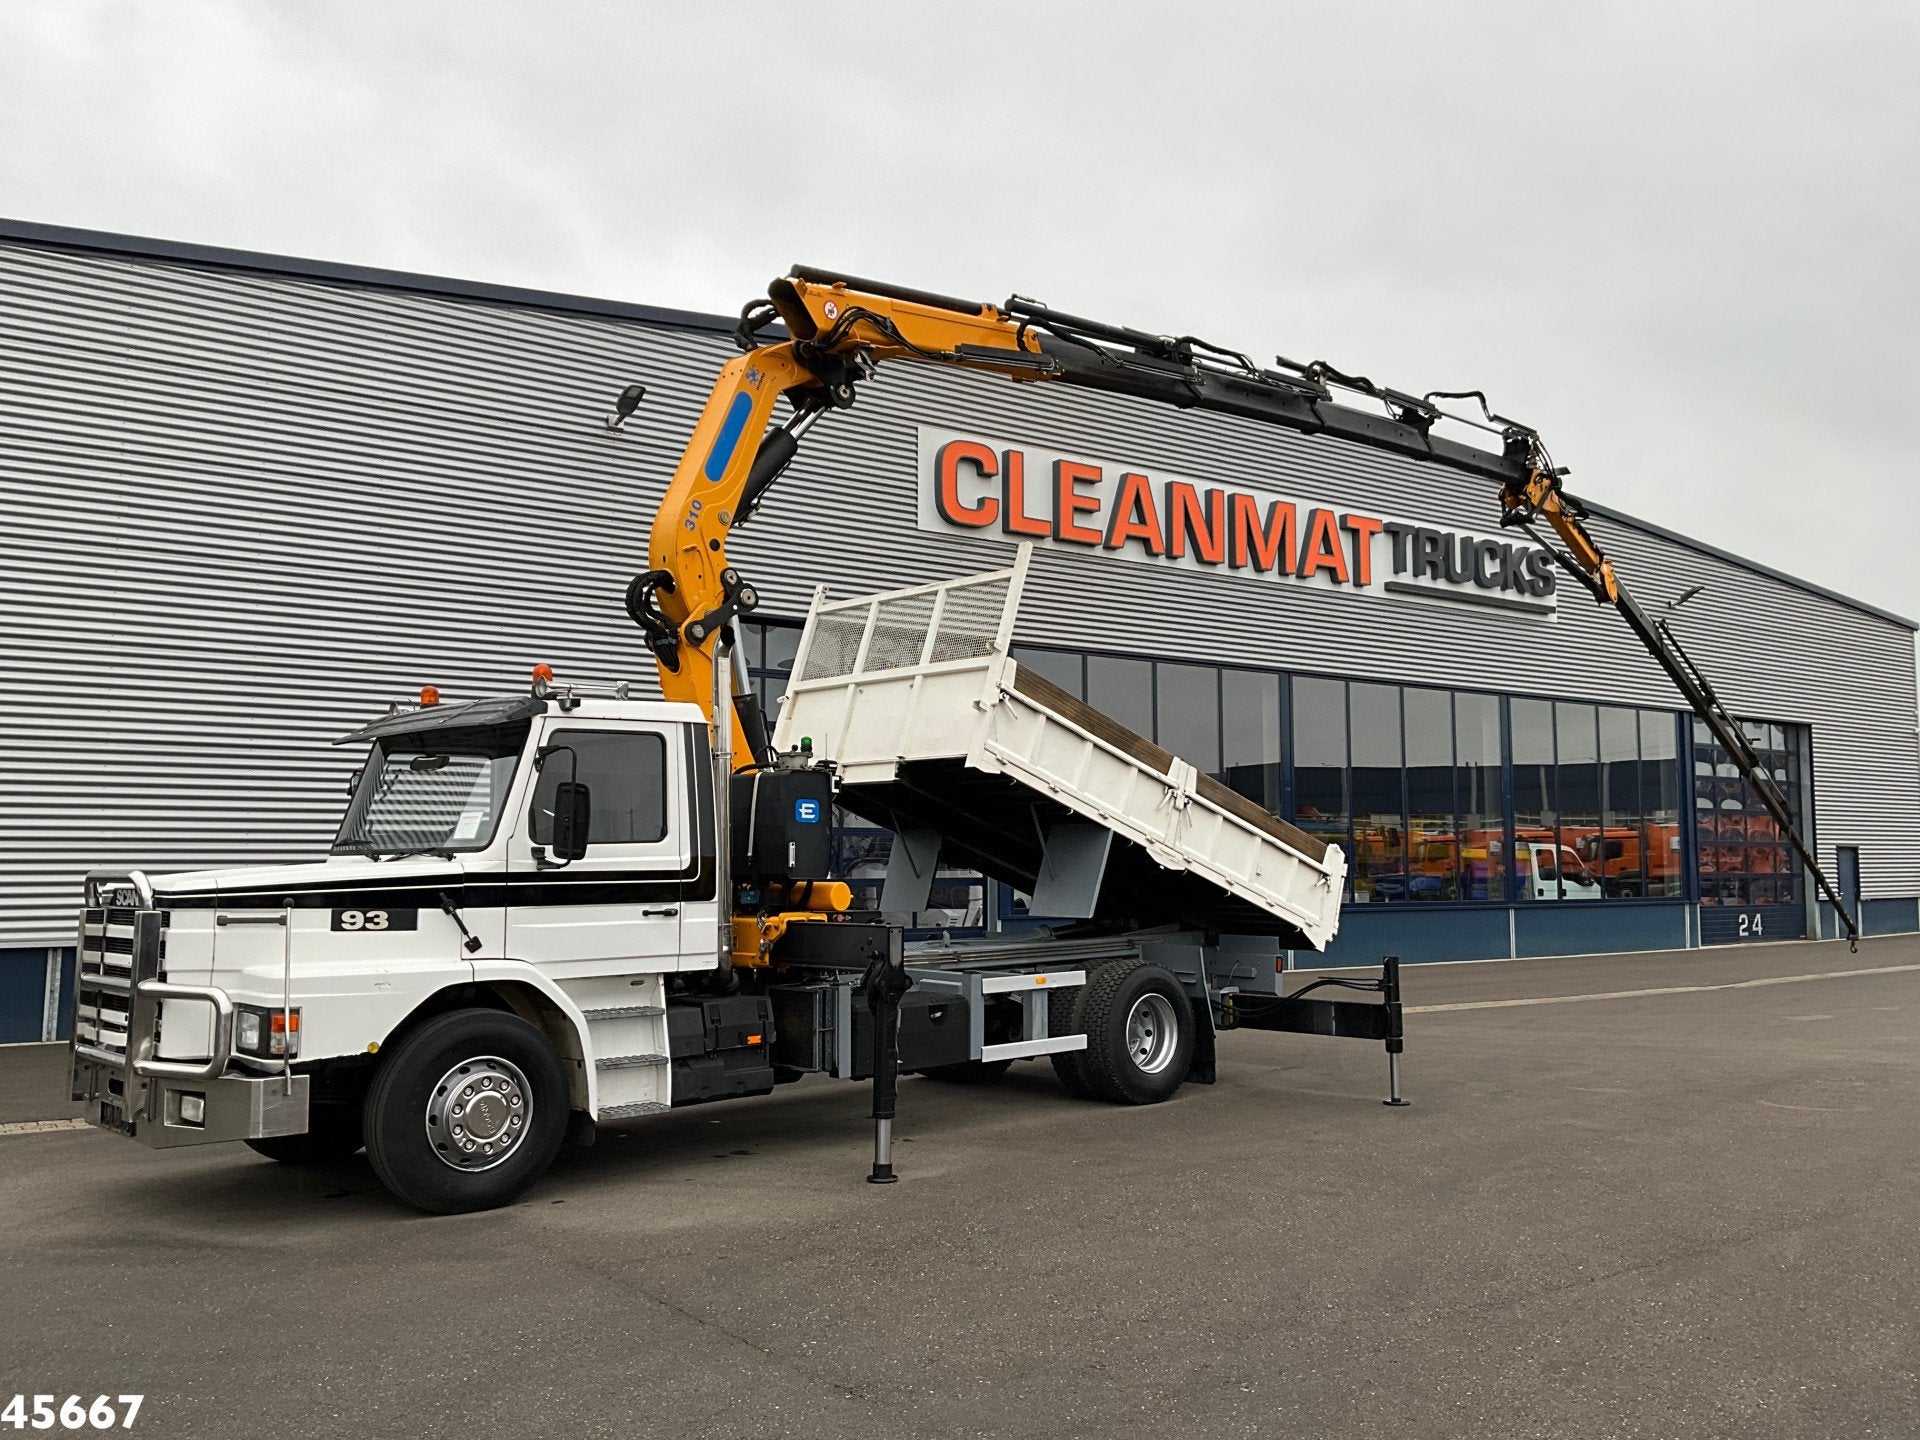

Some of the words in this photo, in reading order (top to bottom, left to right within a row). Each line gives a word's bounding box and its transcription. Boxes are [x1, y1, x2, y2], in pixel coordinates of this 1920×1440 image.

[685, 499, 702, 531] 310
[934, 439, 1383, 588] CLEANMAT
[1384, 521, 1556, 598] TRUCKS
[116, 888, 140, 906] SCAN
[341, 910, 389, 930] 93
[1738, 913, 1763, 936] 24
